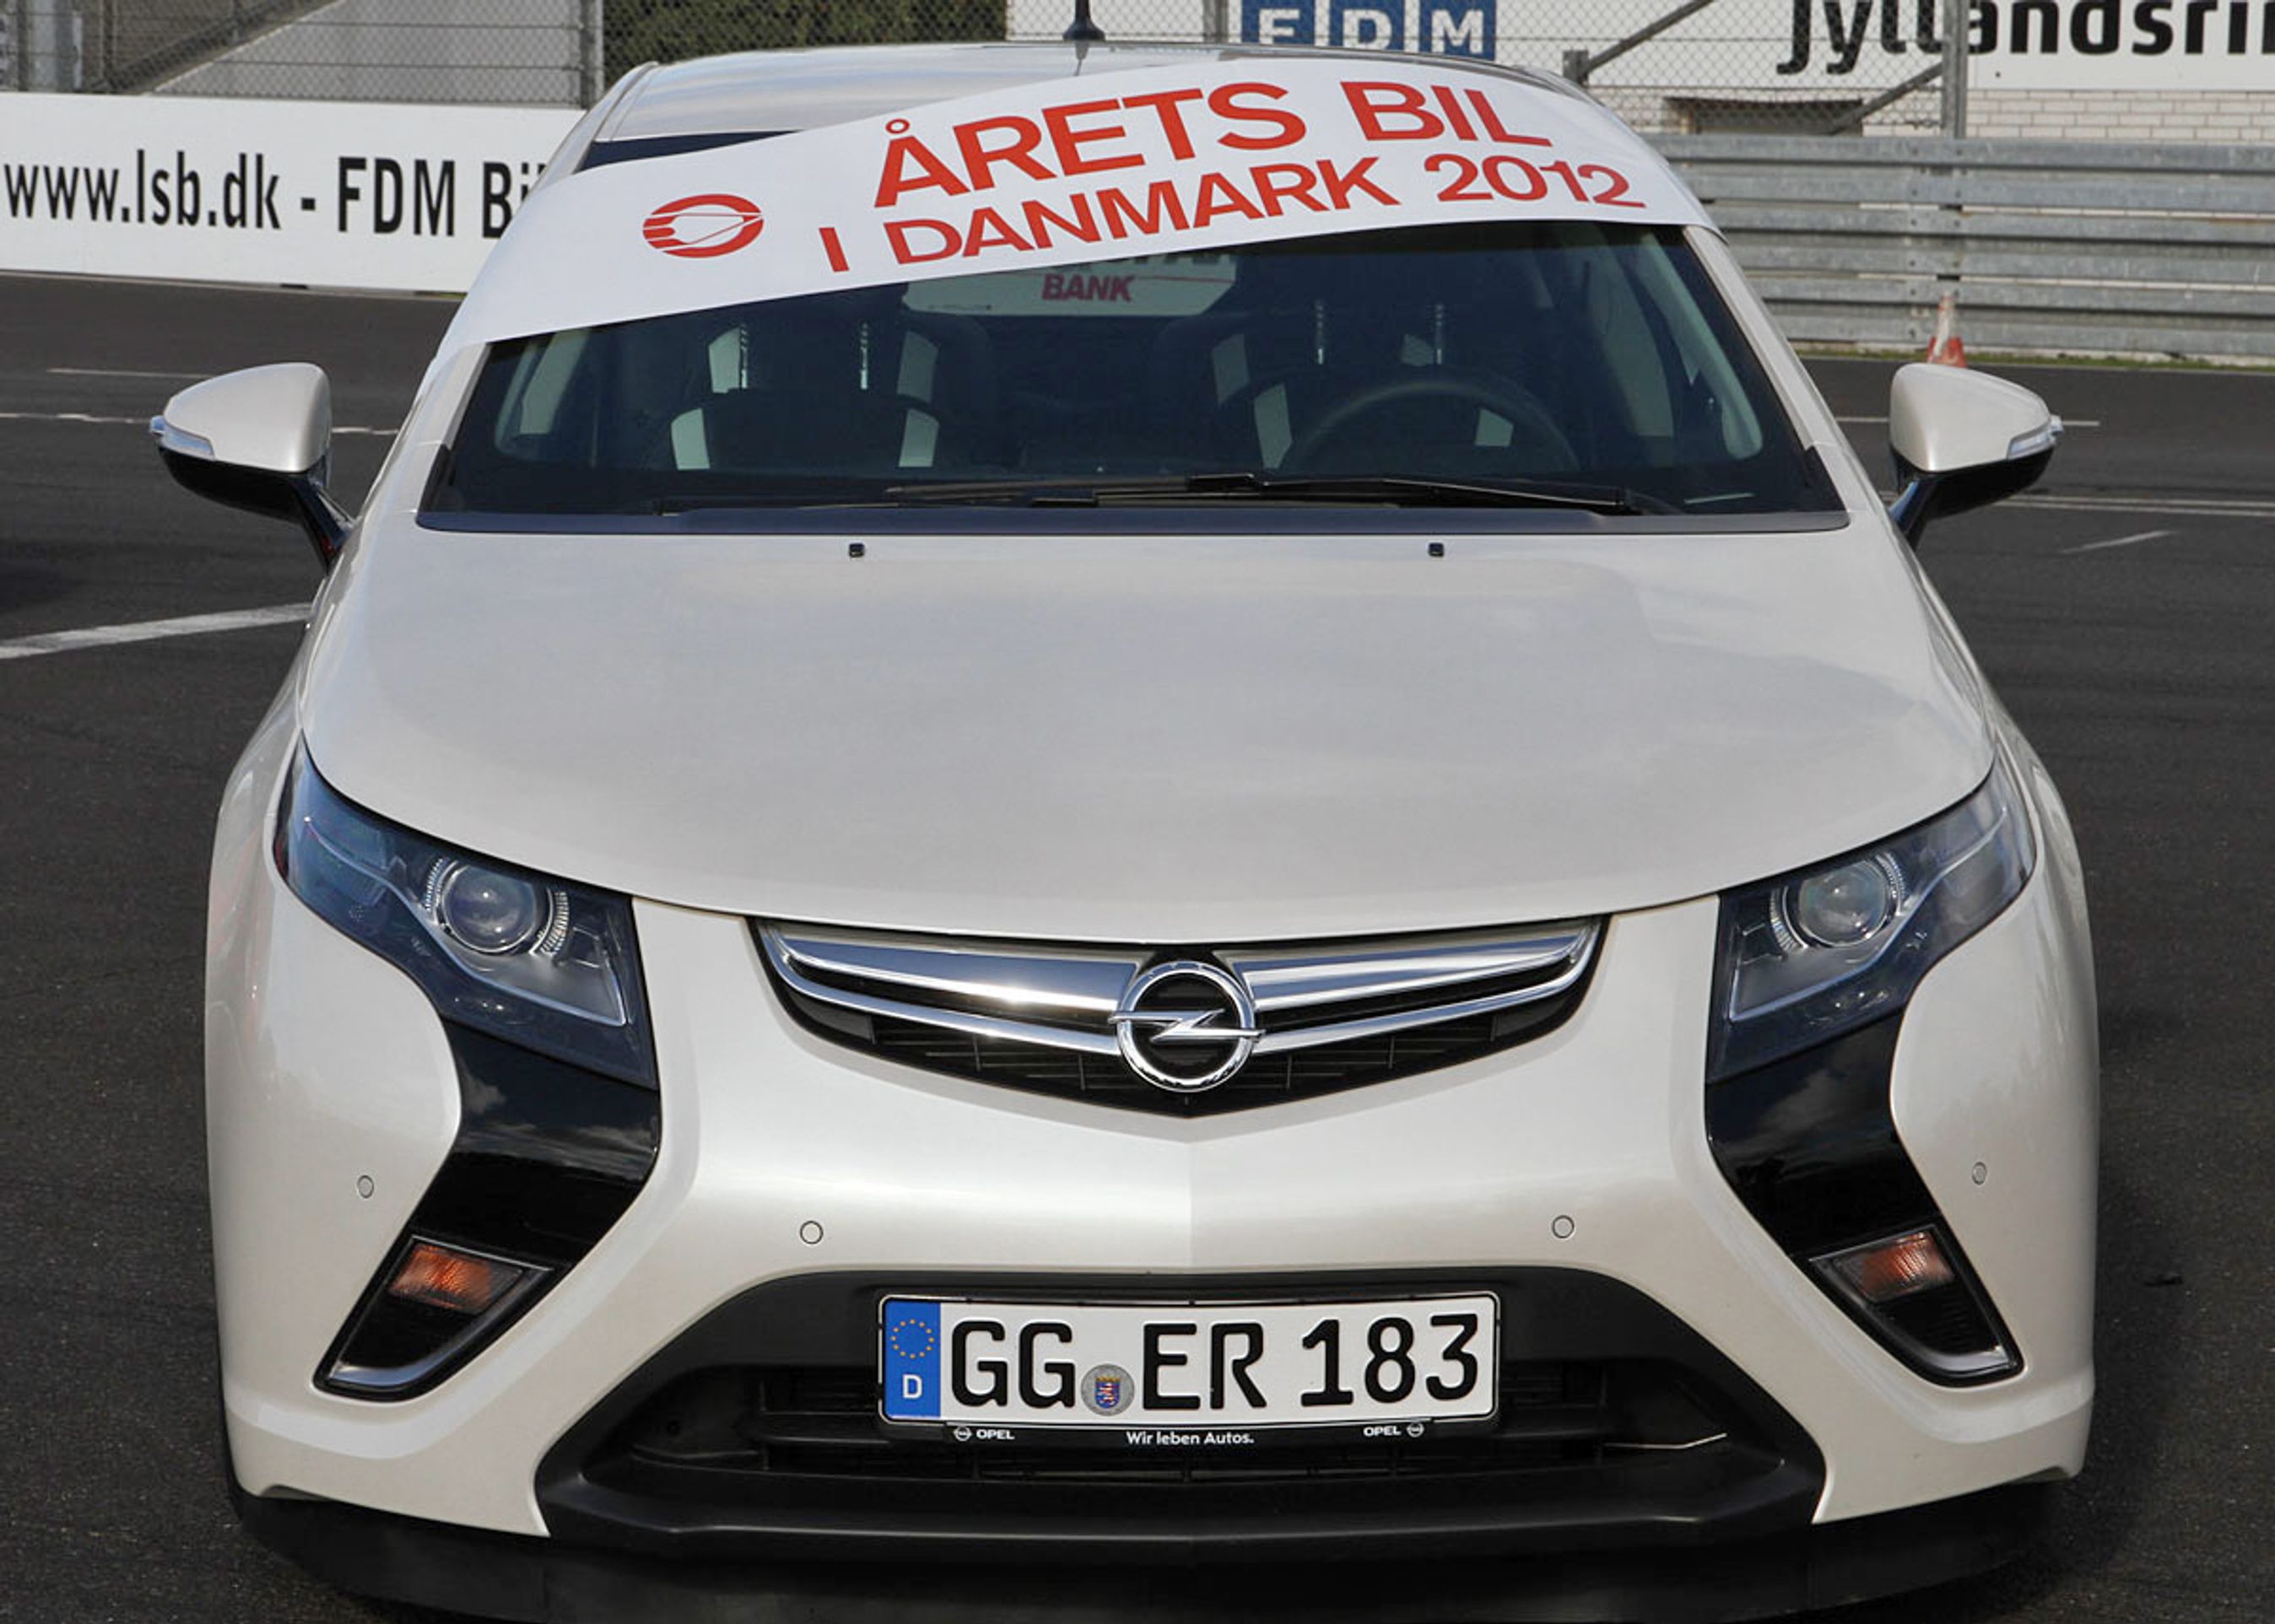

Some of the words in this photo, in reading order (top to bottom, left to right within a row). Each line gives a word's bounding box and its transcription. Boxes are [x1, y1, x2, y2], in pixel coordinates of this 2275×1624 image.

[1258, 8, 1483, 54] FDM
[1776, 0, 2275, 74] Jyllandsri
[874, 82, 1306, 208] ÅRETS
[1341, 81, 1551, 146] BIL
[4, 148, 281, 229] www.lsb.dk
[338, 156, 455, 237] FDM
[820, 227, 850, 272] I
[884, 156, 1399, 265] DANMARK
[1424, 154, 1645, 208] 2012
[1042, 274, 1134, 301] BANK
[951, 1320, 1076, 1410] GG
[1143, 1321, 1267, 1411] ER
[1300, 1313, 1478, 1408] 183
[902, 1373, 922, 1399] D
[975, 1428, 1015, 1440] OPEL
[1126, 1431, 1154, 1445] Wir
[1156, 1431, 1201, 1445] leben
[1203, 1432, 1255, 1445] Autos.
[1363, 1425, 1402, 1438] OPEL
